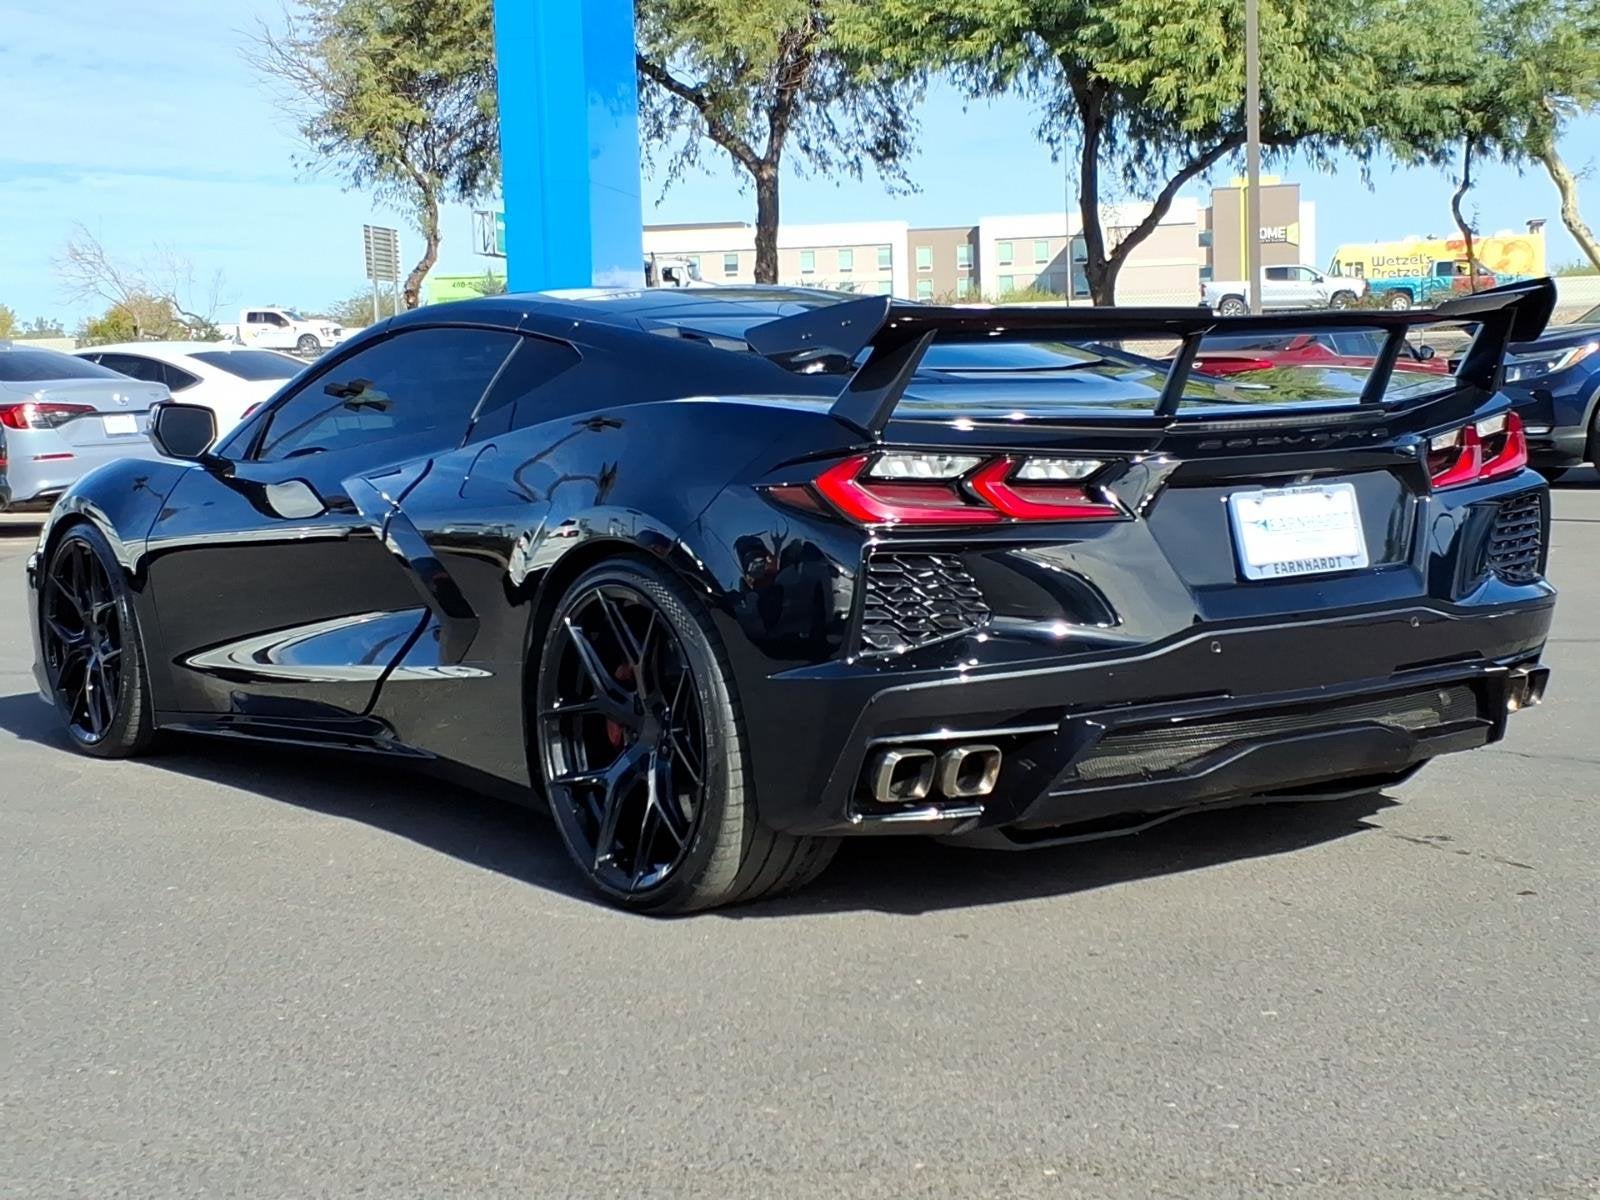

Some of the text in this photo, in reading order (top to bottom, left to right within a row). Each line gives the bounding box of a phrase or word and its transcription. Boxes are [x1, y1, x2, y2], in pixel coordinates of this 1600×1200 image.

[1259, 226, 1287, 240] OME
[1371, 253, 1434, 267] Wetzel's
[1371, 265, 1431, 278] Pretzel
[1273, 556, 1342, 575] EARNHARDT
